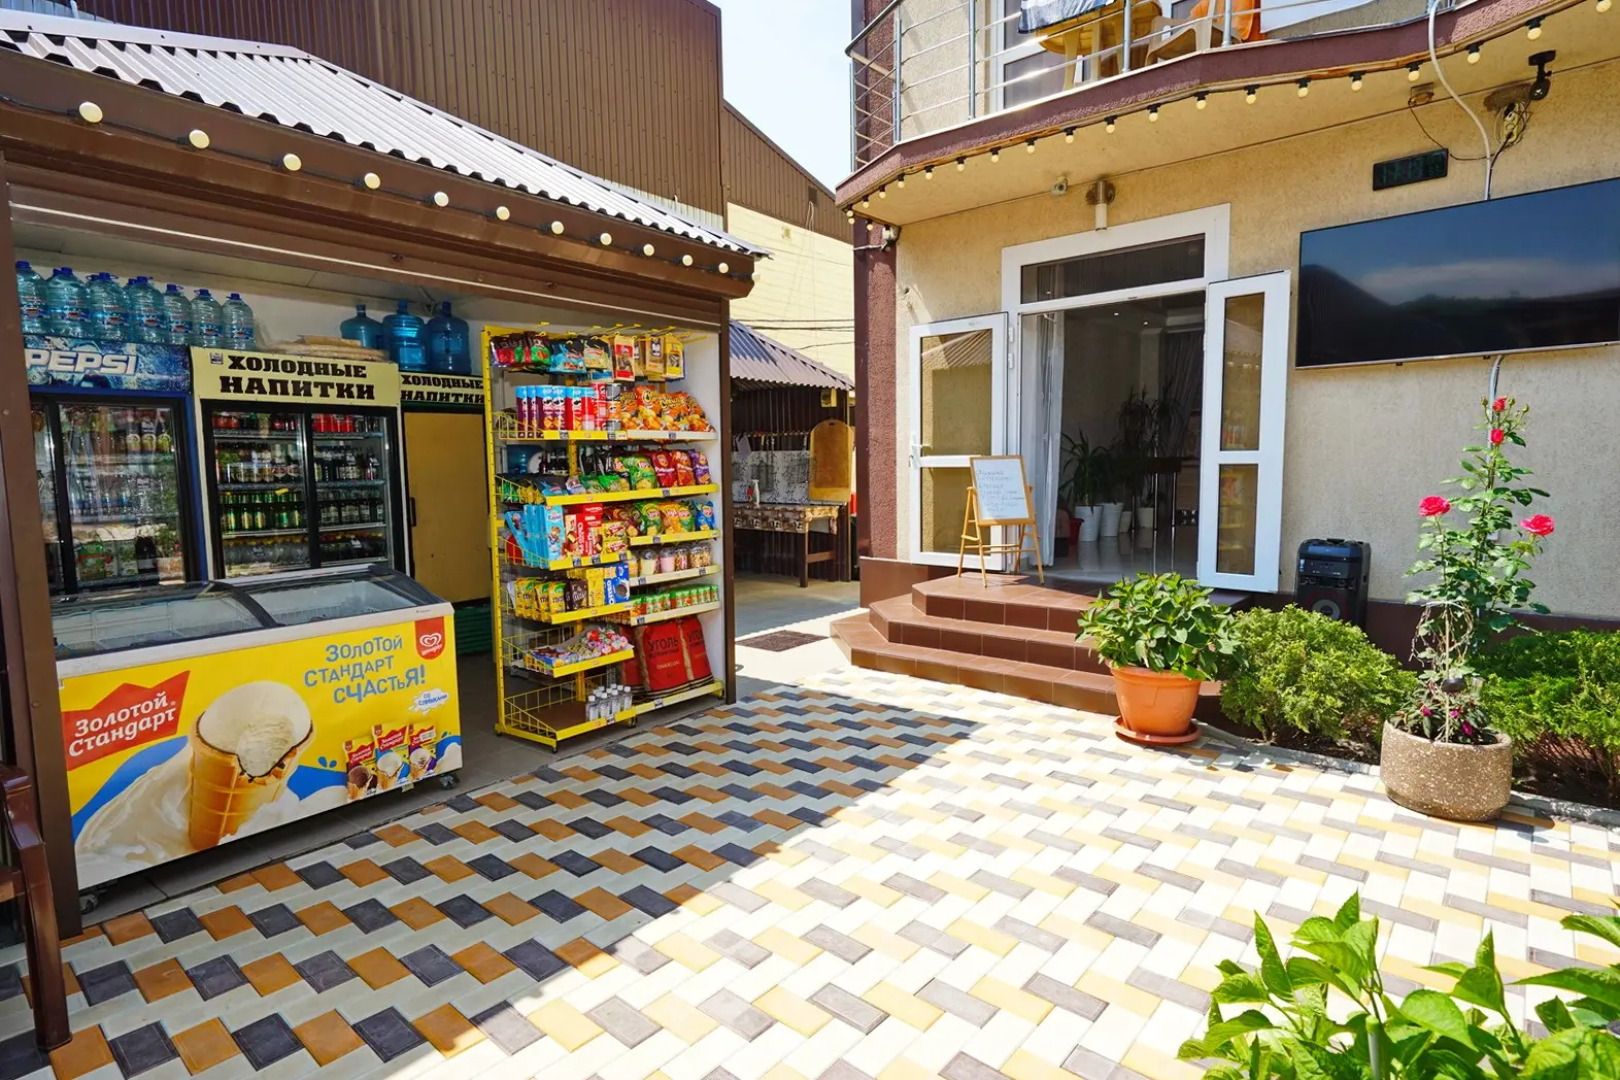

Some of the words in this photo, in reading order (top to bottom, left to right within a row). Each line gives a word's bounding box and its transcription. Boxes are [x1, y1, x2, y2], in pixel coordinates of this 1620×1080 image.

[228, 355, 367, 379] ХОЛОДНЫЕ
[219, 376, 375, 400] НАПИТКИ
[401, 374, 484, 389] ХОЛОДНЫЕ
[401, 390, 485, 403] НАПИТКИ
[325, 635, 403, 663] ЗОЛОТОЙ
[304, 655, 395, 687] СТАНДАРТ
[333, 664, 426, 704] СЧАСТЬЯ!
[75, 691, 168, 738] Золотой
[69, 708, 176, 757] Стандарт
